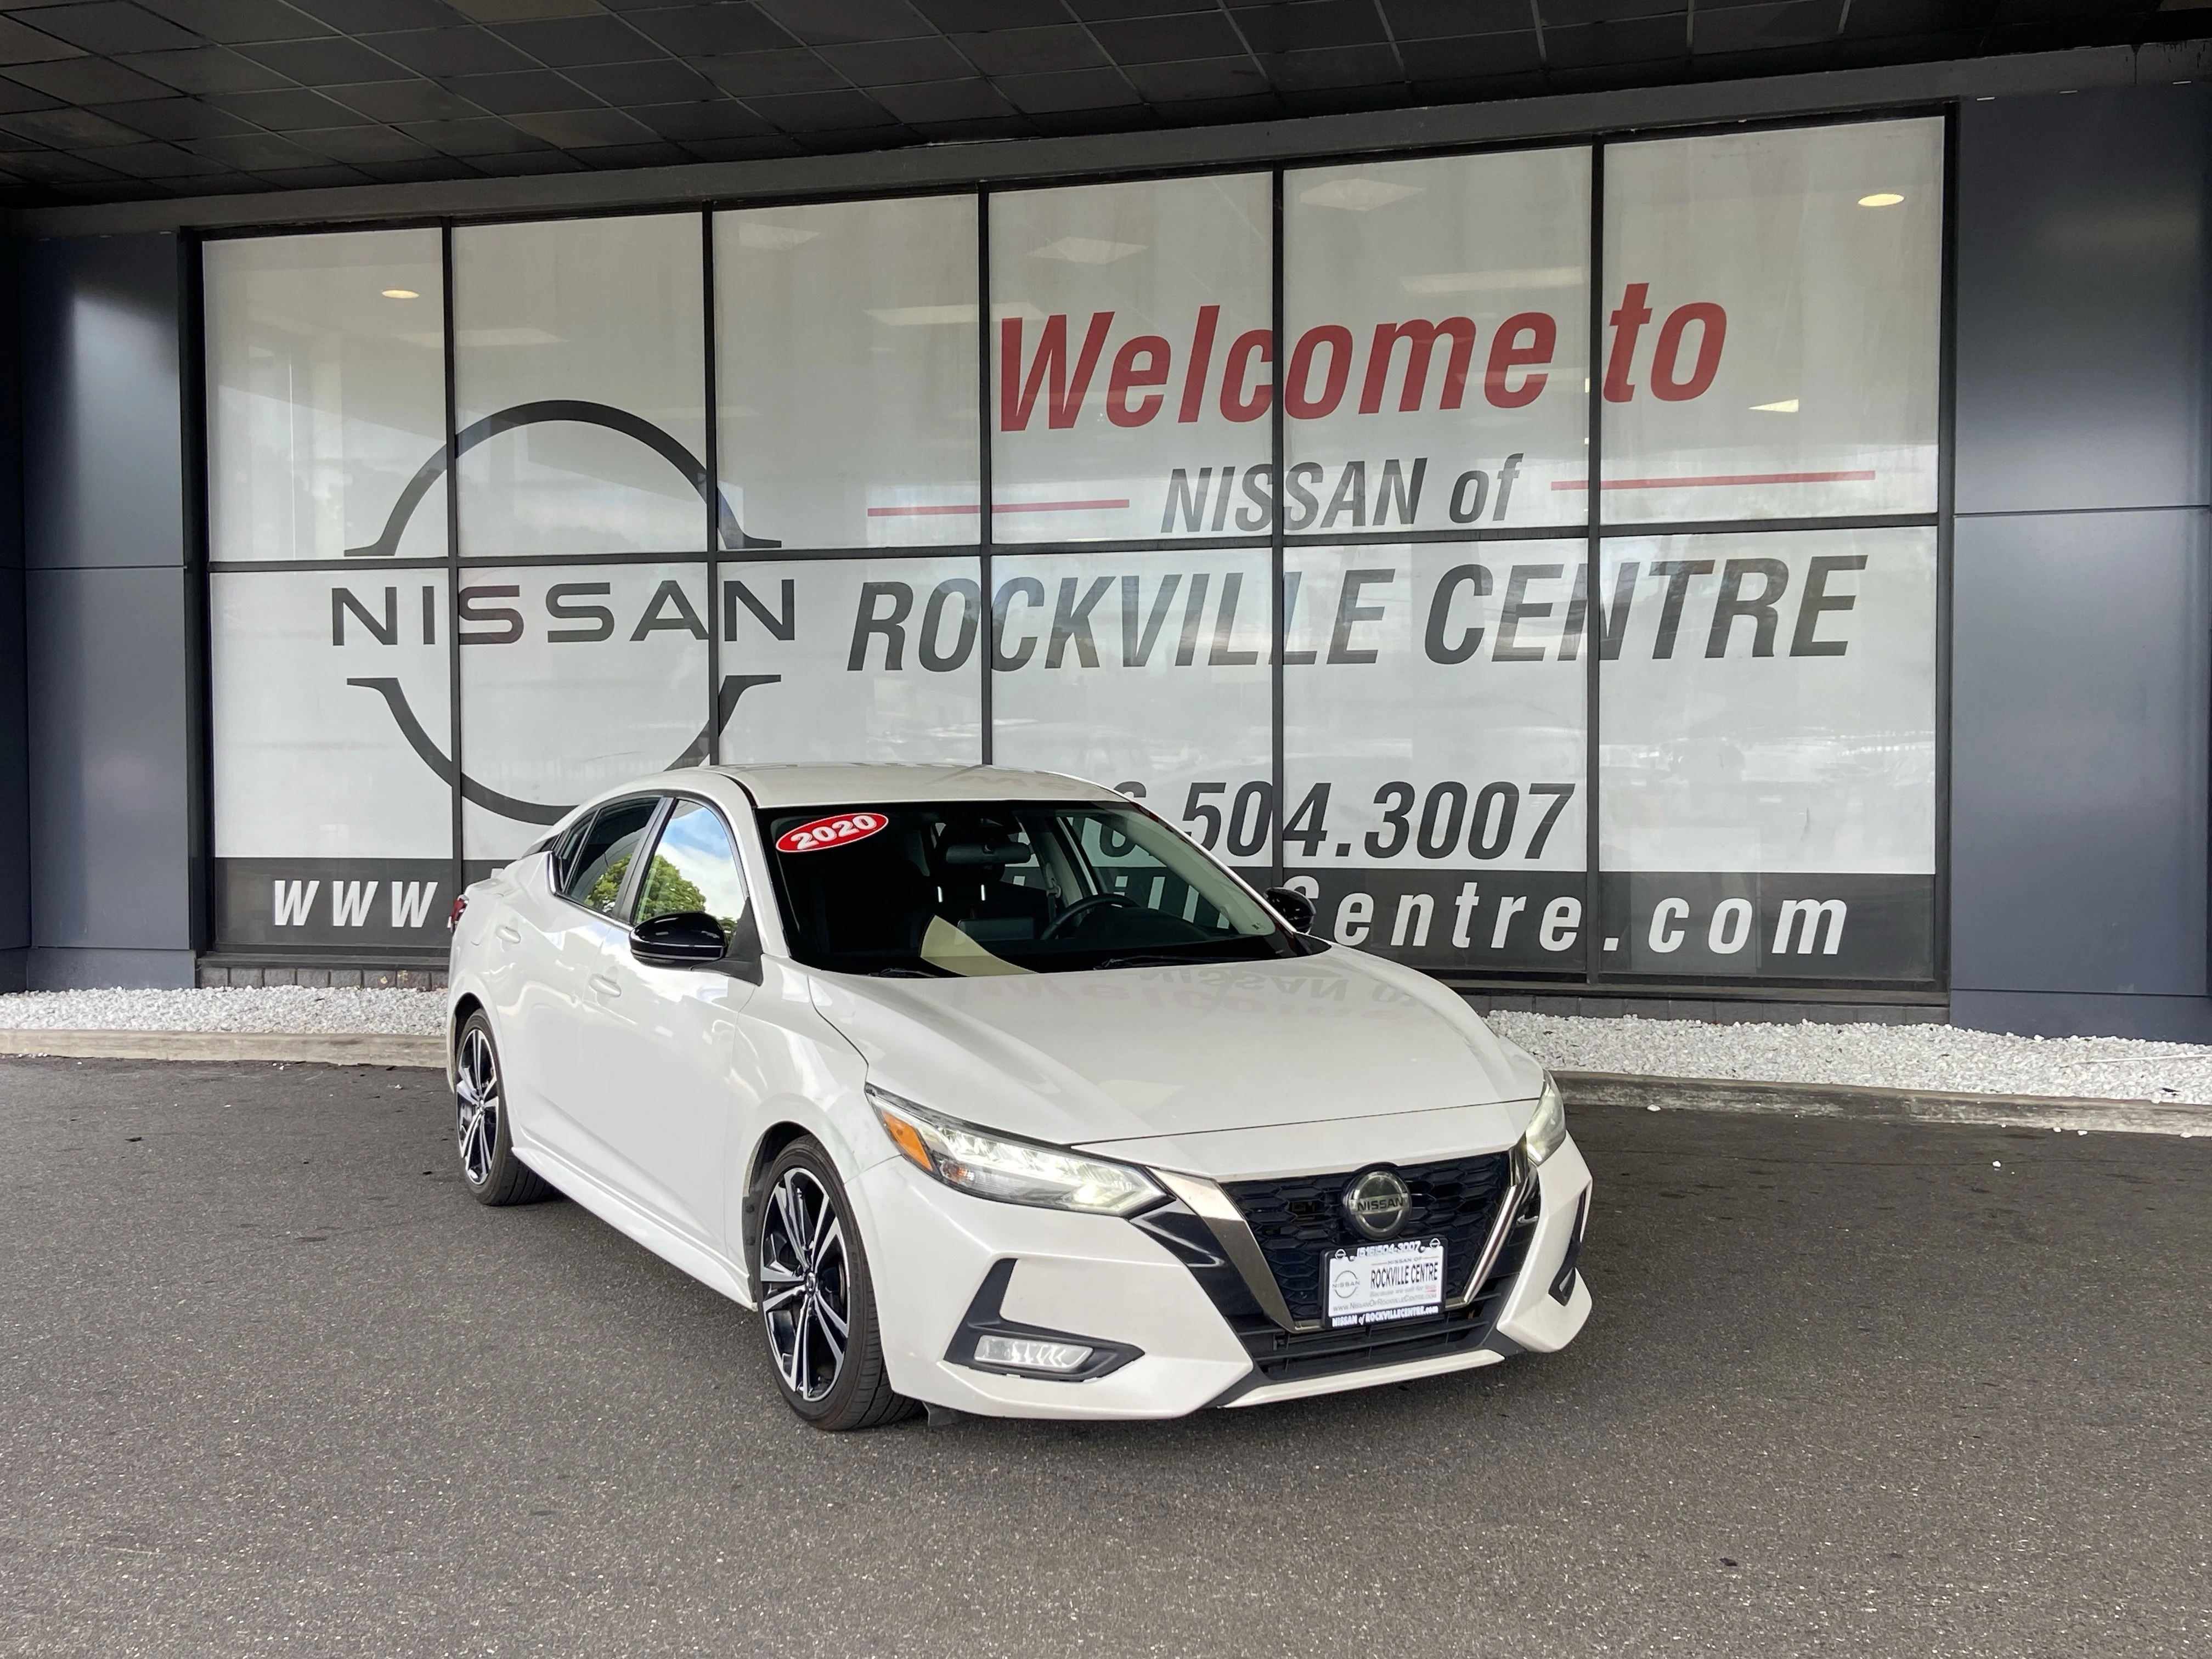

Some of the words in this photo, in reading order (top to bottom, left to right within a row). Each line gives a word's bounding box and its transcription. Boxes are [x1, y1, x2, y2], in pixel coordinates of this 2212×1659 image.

[1001, 305, 1556, 432] Welcome
[1603, 283, 1727, 403] to
[1161, 458, 1427, 533] NISSAN
[1449, 453, 1523, 524] of
[331, 579, 795, 646] NISSAN
[847, 569, 1396, 673] ROCKVILLE
[1424, 555, 1868, 665] CENTRE
[791, 815, 877, 850] 2020
[1357, 1197, 1403, 1211] NISSAN
[1332, 1280, 1360, 1289] NISSAN
[1371, 1266, 1409, 1289] ROCKVILLE
[1410, 1262, 1438, 1284] CENTRE
[1332, 1314, 1358, 1327] NISSAN
